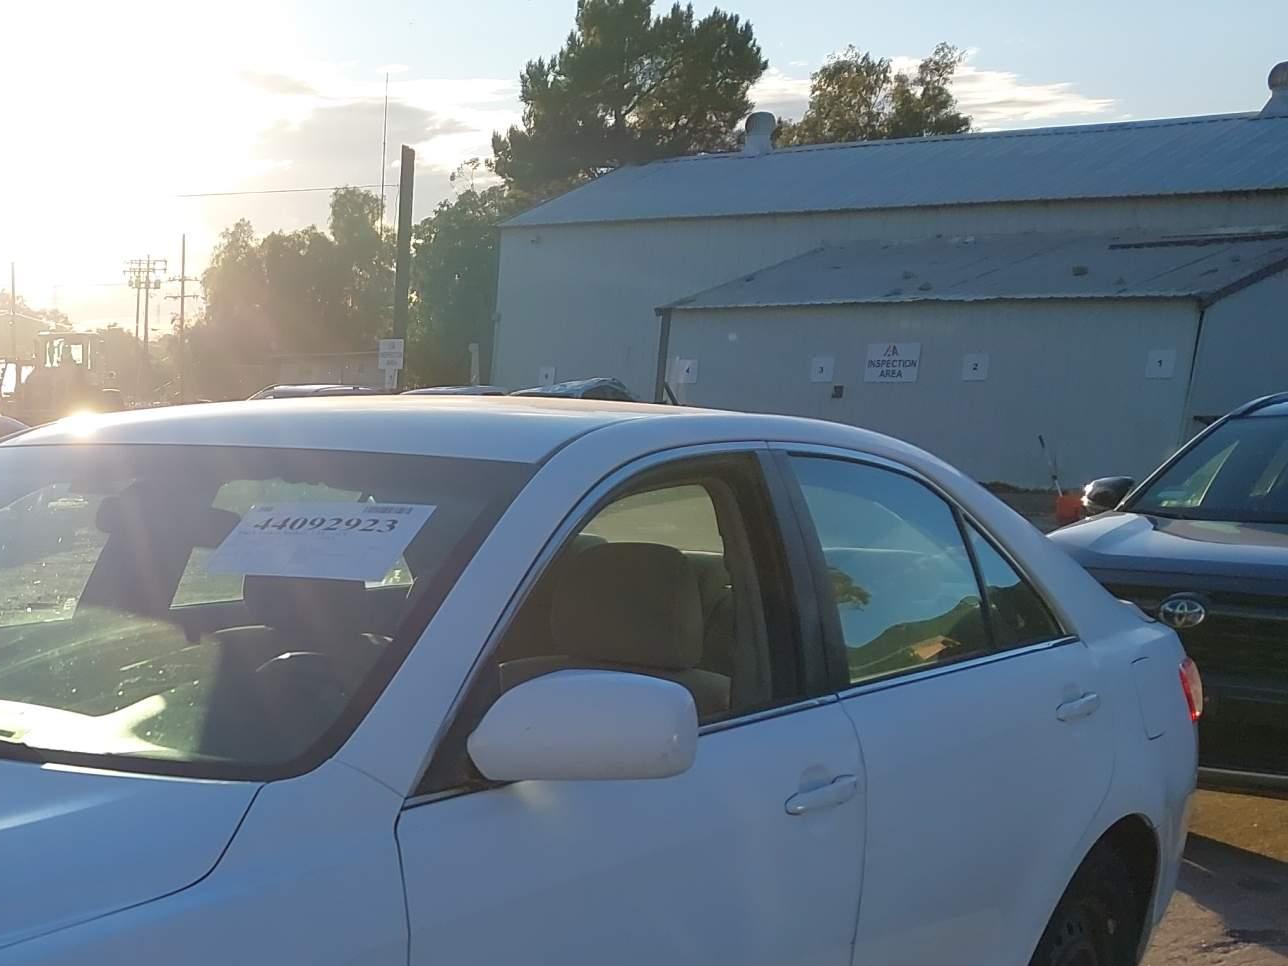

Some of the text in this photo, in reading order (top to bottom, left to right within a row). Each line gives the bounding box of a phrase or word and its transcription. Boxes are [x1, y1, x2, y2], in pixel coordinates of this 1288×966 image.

[867, 359, 918, 369] INSPECTION
[879, 369, 903, 378] AREA
[253, 516, 399, 533] 44092923
